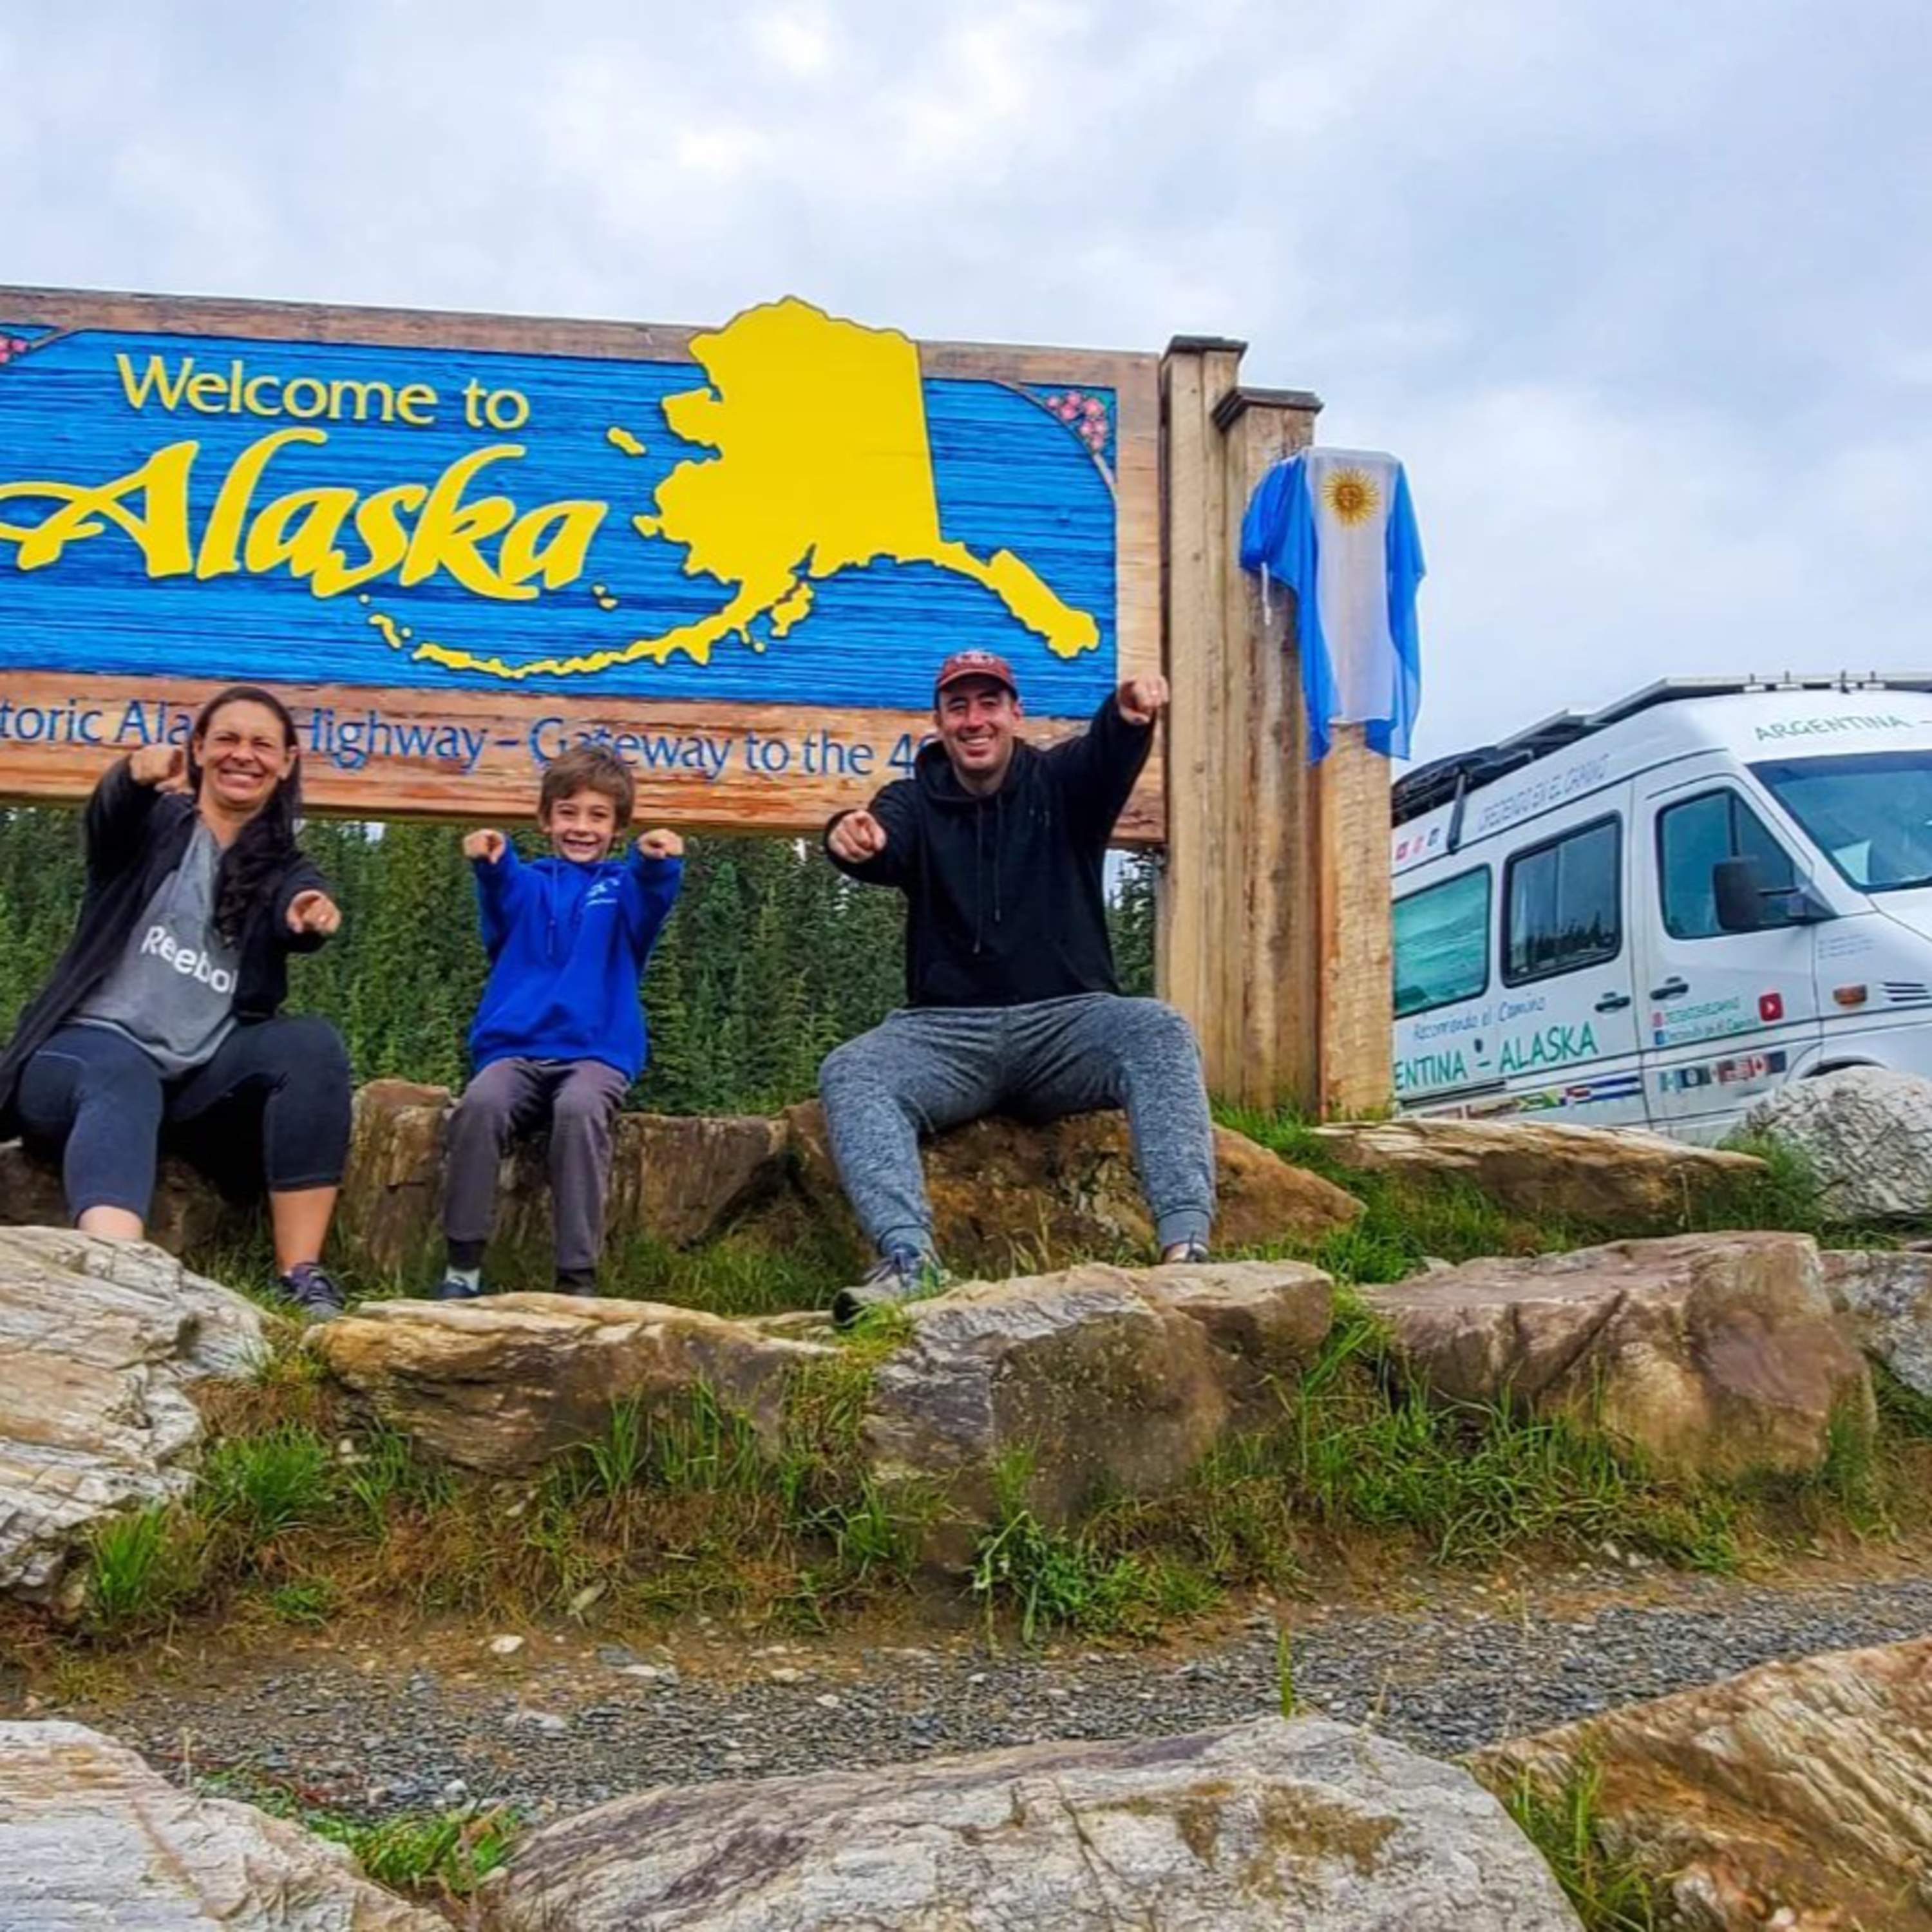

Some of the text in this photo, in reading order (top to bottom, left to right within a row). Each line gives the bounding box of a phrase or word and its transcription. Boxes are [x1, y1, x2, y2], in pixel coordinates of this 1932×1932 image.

[117, 354, 529, 430] Welcome to
[0, 428, 608, 601] Alaska
[114, 699, 192, 745] Ala
[744, 731, 791, 772] to
[804, 730, 875, 775] the
[887, 732, 938, 776] 4
[1755, 715, 1914, 741] ARGENTINA
[1394, 1049, 1468, 1090] ENTINA
[1499, 1021, 1598, 1073] ALASKA
